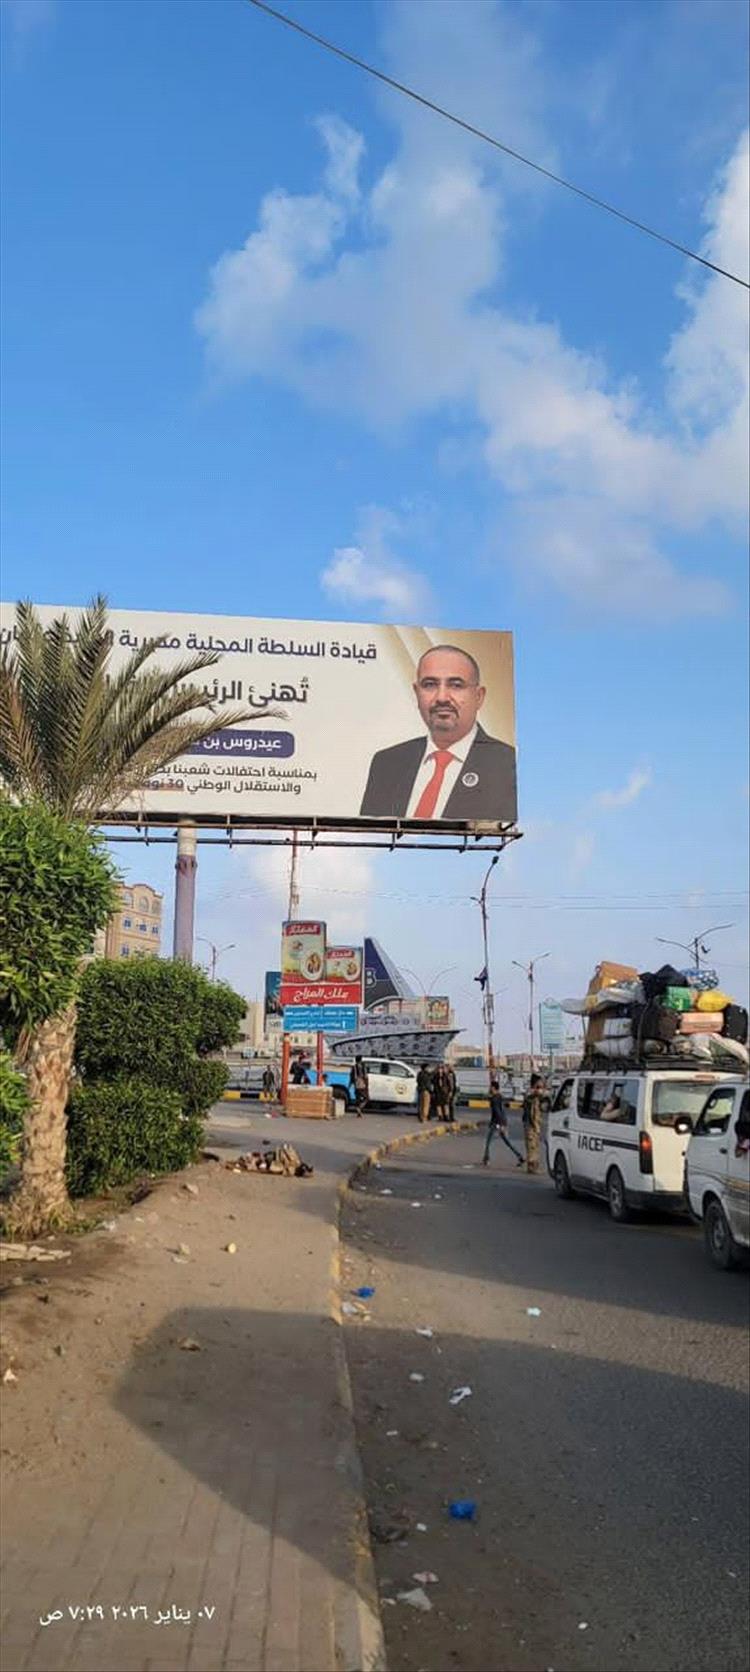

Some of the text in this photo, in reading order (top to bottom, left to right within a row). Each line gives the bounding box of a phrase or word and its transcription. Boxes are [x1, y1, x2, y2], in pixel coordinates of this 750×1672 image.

[186, 633, 253, 655] المحلية
[258, 637, 325, 657] السلطة
[330, 641, 377, 664] قيادة
[203, 736, 220, 750] بن
[223, 738, 282, 751] عيدروس
[173, 763, 210, 777] شعبنا
[213, 765, 265, 777] احتفالات
[268, 767, 318, 783] بمناسبة
[187, 779, 231, 795] الوطني
[233, 780, 301, 795] والاستقلال
